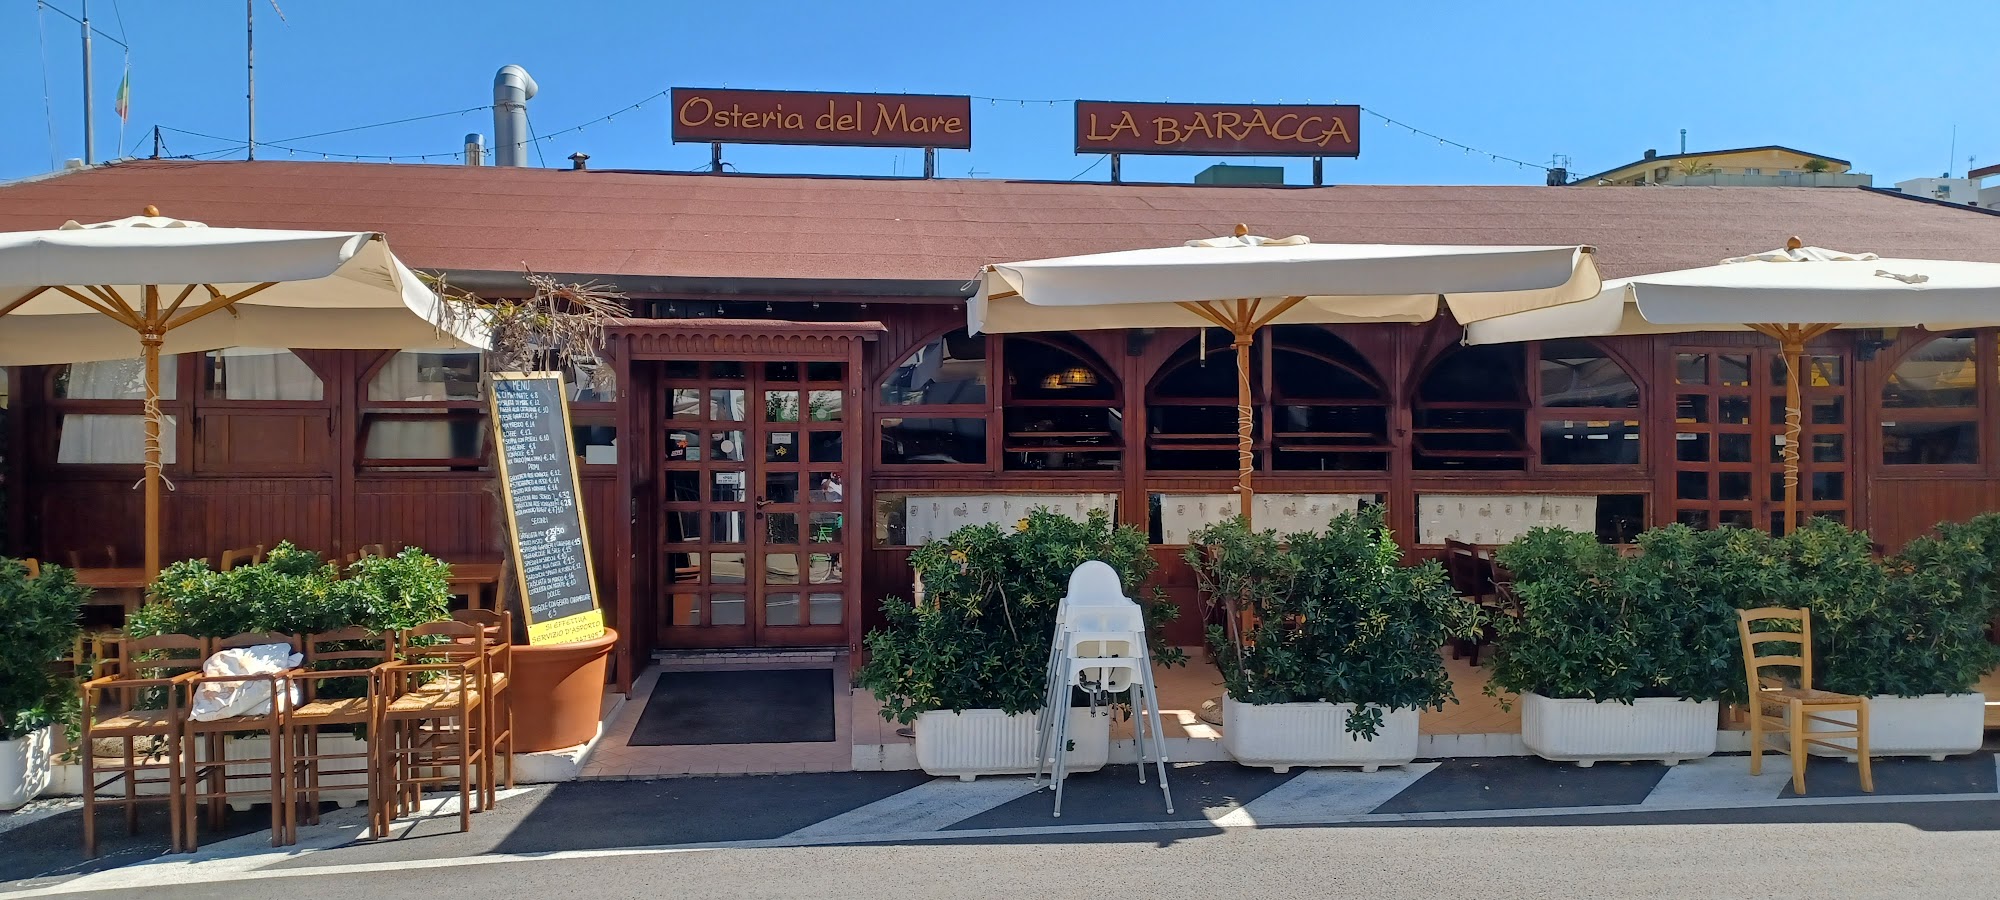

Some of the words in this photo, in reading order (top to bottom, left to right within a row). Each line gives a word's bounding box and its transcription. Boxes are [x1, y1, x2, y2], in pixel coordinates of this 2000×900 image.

[679, 96, 804, 130] Osteria
[815, 97, 863, 132] del
[872, 102, 964, 136] Mare
[1086, 110, 1140, 142] LA
[1152, 110, 1354, 146] BARACCA
[531, 630, 564, 643] SERVIZIO
[565, 621, 601, 634] D'ASPORTO
